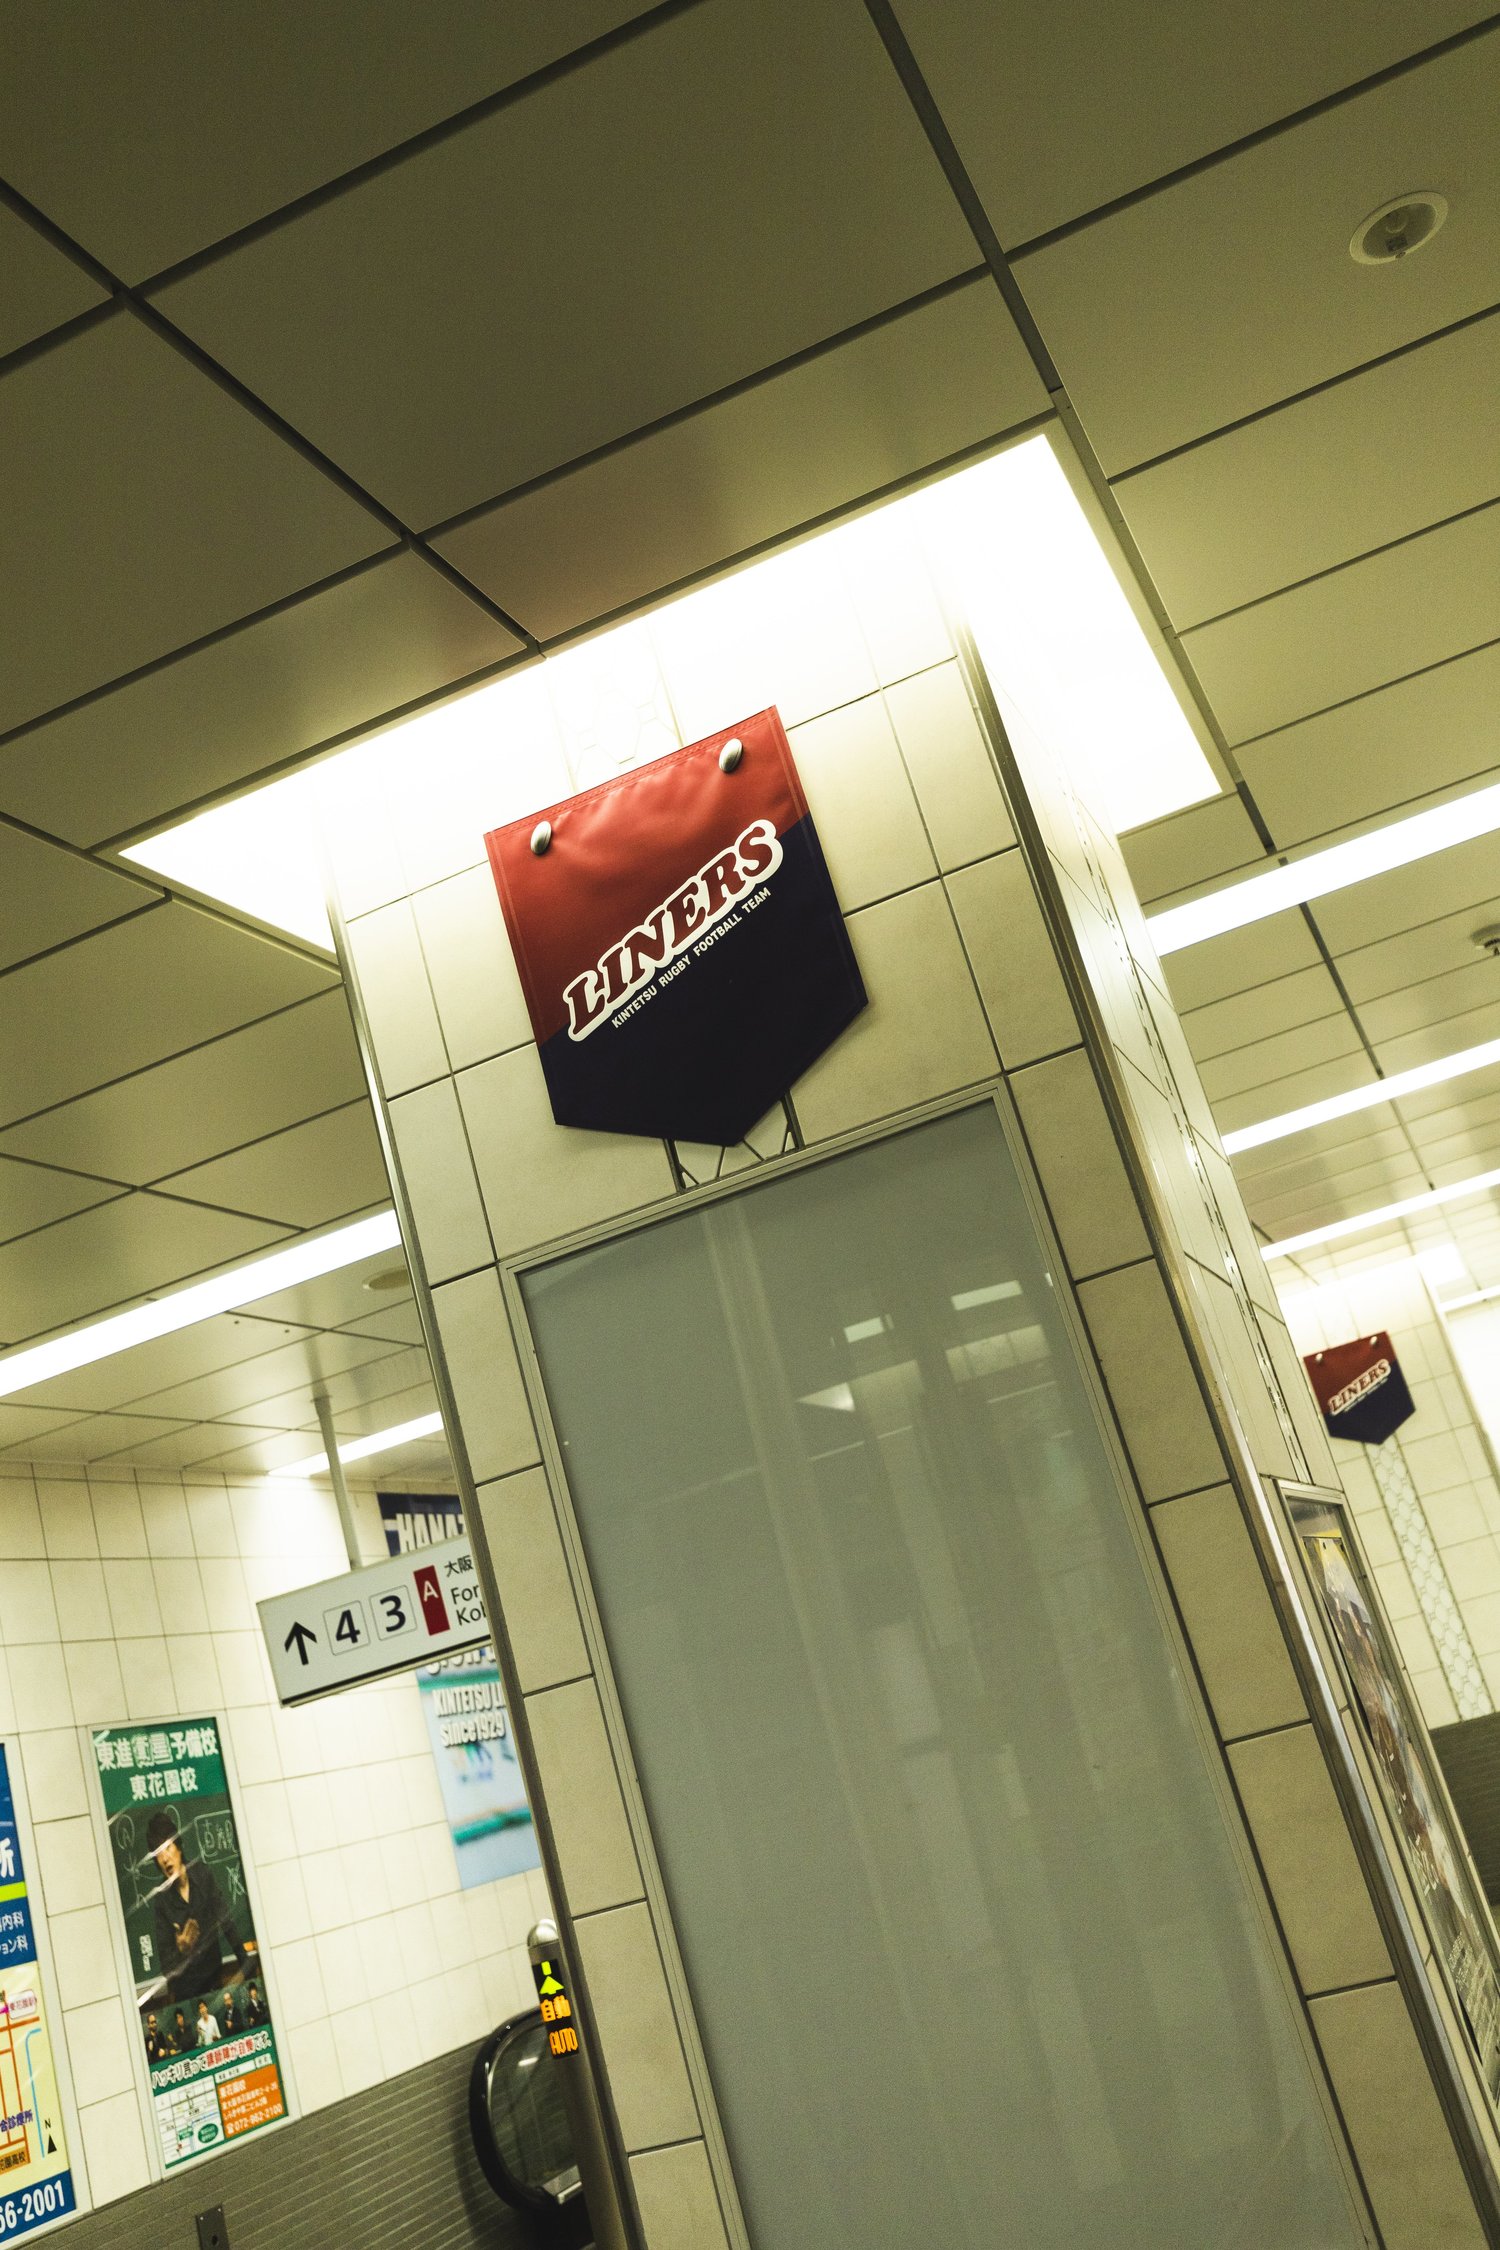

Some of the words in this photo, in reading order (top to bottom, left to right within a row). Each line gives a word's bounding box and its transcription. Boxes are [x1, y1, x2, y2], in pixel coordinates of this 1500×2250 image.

[563, 819, 784, 1042] LINERS
[611, 985, 658, 1028] KINTETSU
[658, 954, 691, 988] RUGBY
[693, 914, 742, 957] FOOTBALL
[741, 887, 771, 914] TEAM
[1327, 1358, 1391, 1416] LINERS
[336, 1609, 361, 1643] 4
[380, 1595, 406, 1632] 3
[423, 1581, 439, 1602] A
[451, 1585, 479, 1605] For
[433, 1683, 492, 1717] KINTETSU
[129, 1766, 198, 1801] 東花園校
[540, 1995, 571, 2022] 自動
[549, 2027, 579, 2056] AUTO
[45, 2118, 52, 2130] N
